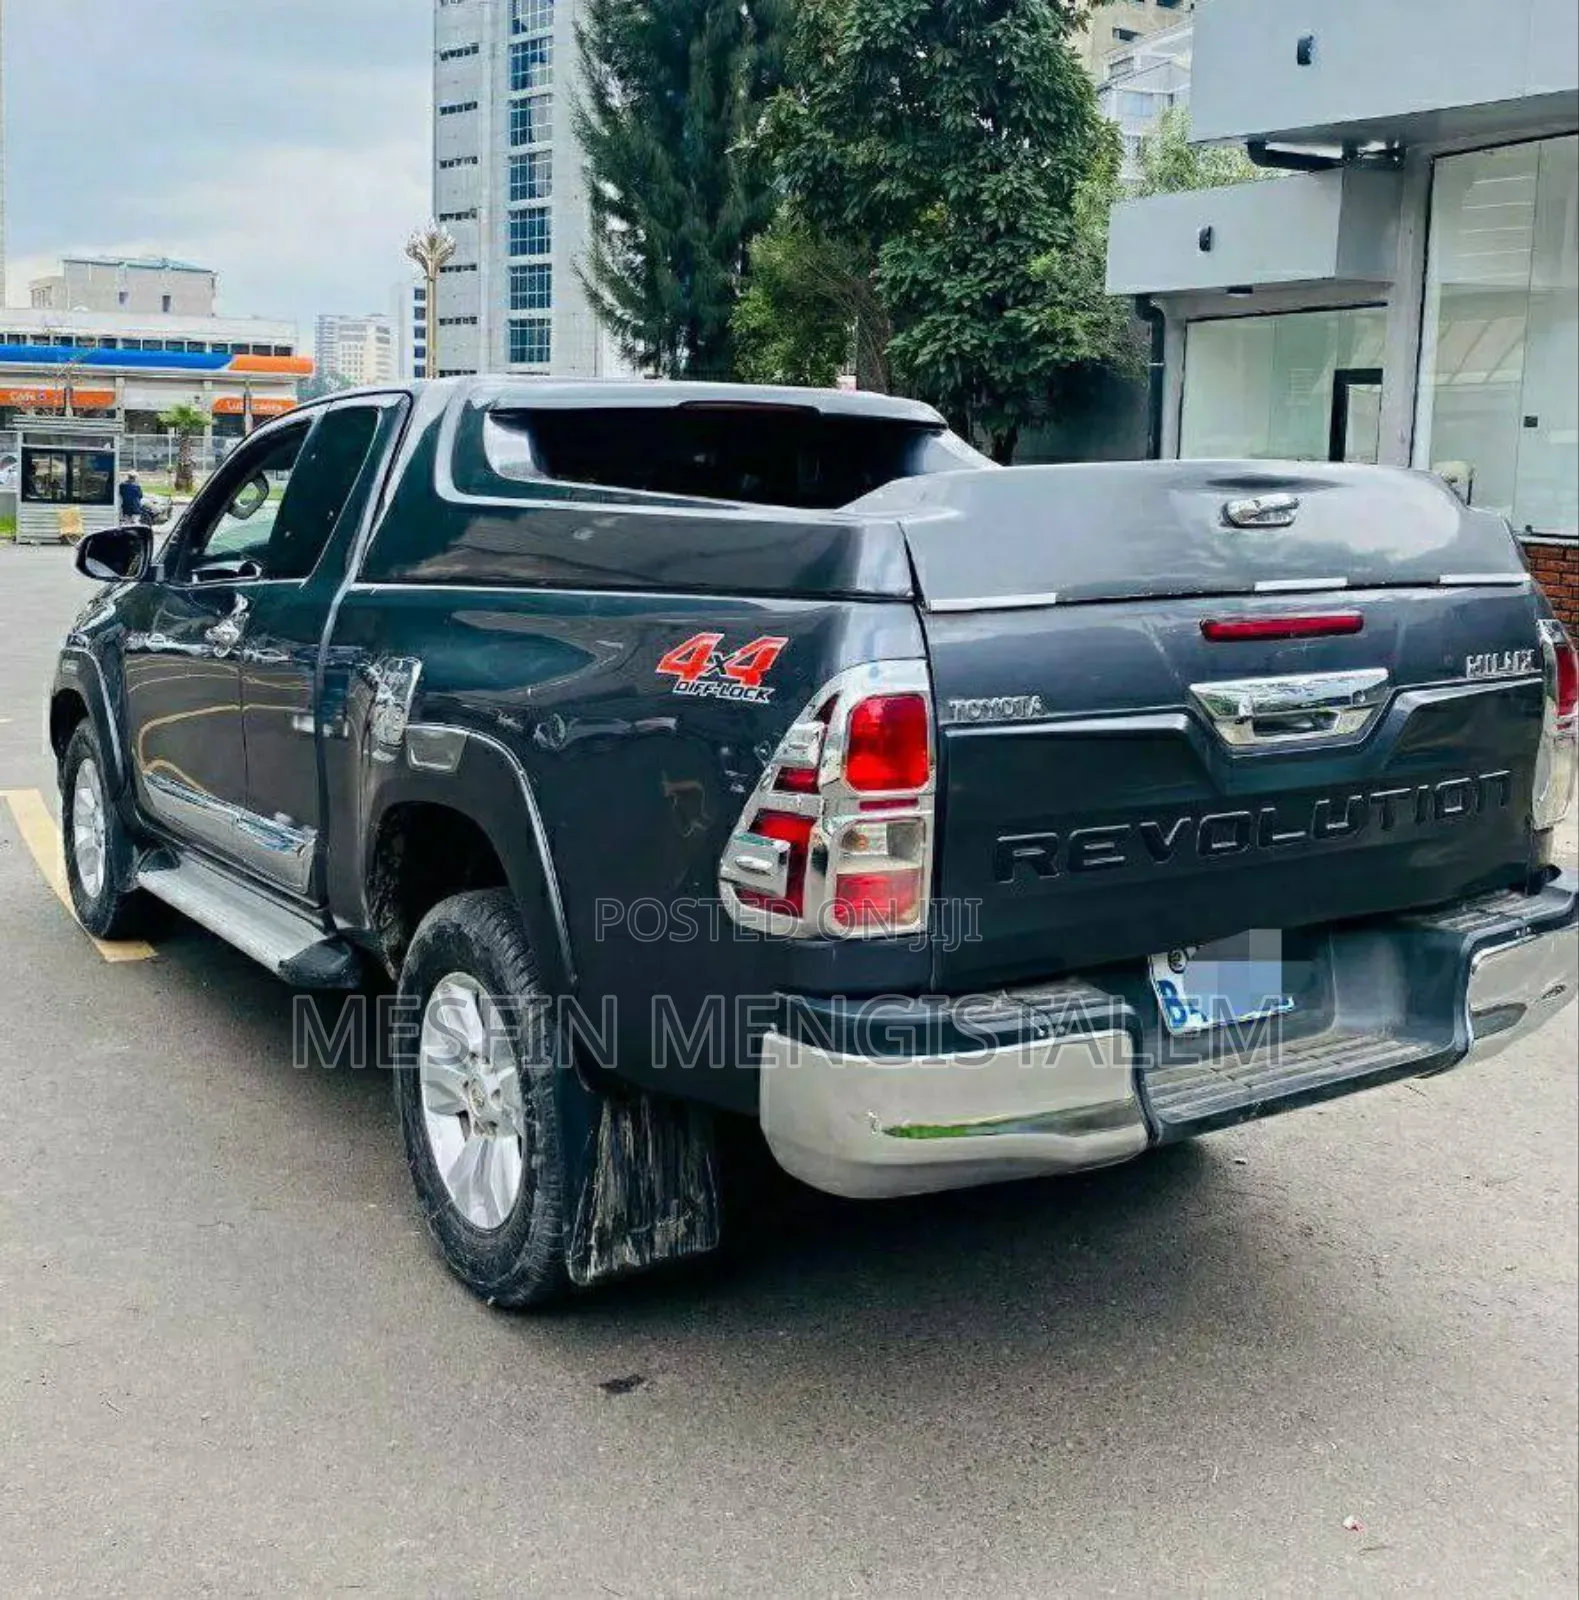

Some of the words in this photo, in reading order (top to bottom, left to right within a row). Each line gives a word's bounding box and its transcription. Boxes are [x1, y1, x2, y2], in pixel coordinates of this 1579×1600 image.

[672, 680, 775, 703] DIFF-LOCK
[948, 695, 1046, 722] TOYOTA
[995, 771, 1511, 884] REVOLUTION
